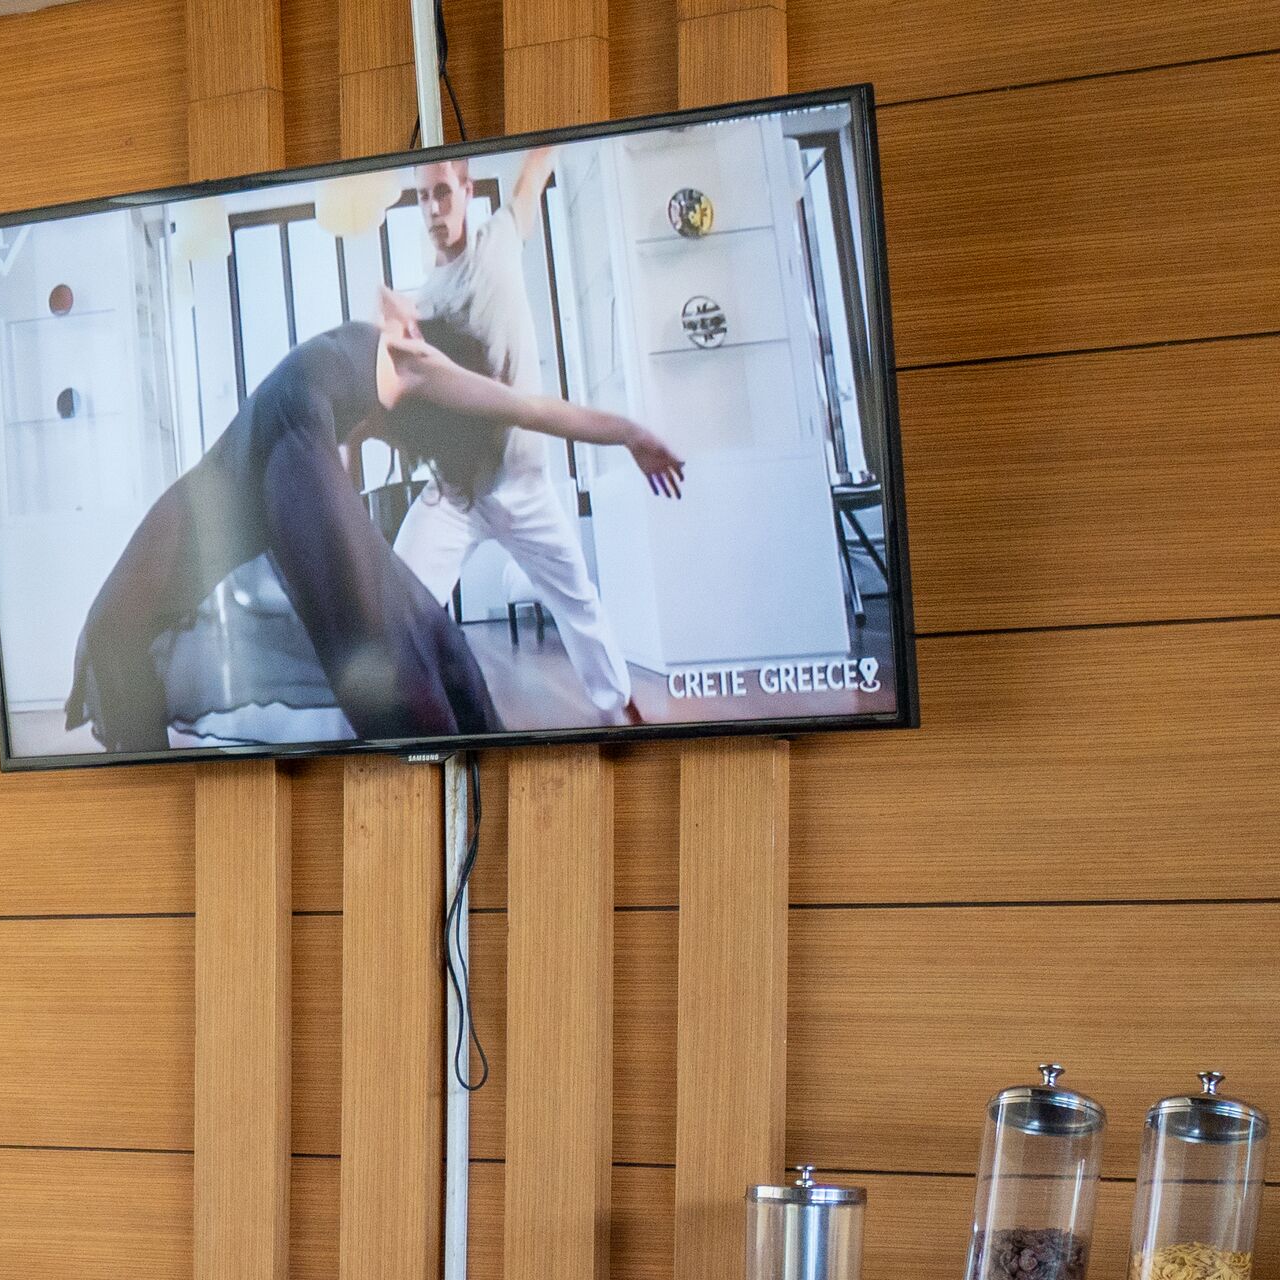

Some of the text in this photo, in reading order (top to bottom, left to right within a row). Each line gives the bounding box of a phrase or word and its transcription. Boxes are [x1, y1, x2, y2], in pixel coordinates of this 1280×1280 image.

[668, 660, 859, 698] CRETE GREECE
[408, 754, 439, 762] SAMSUNG
